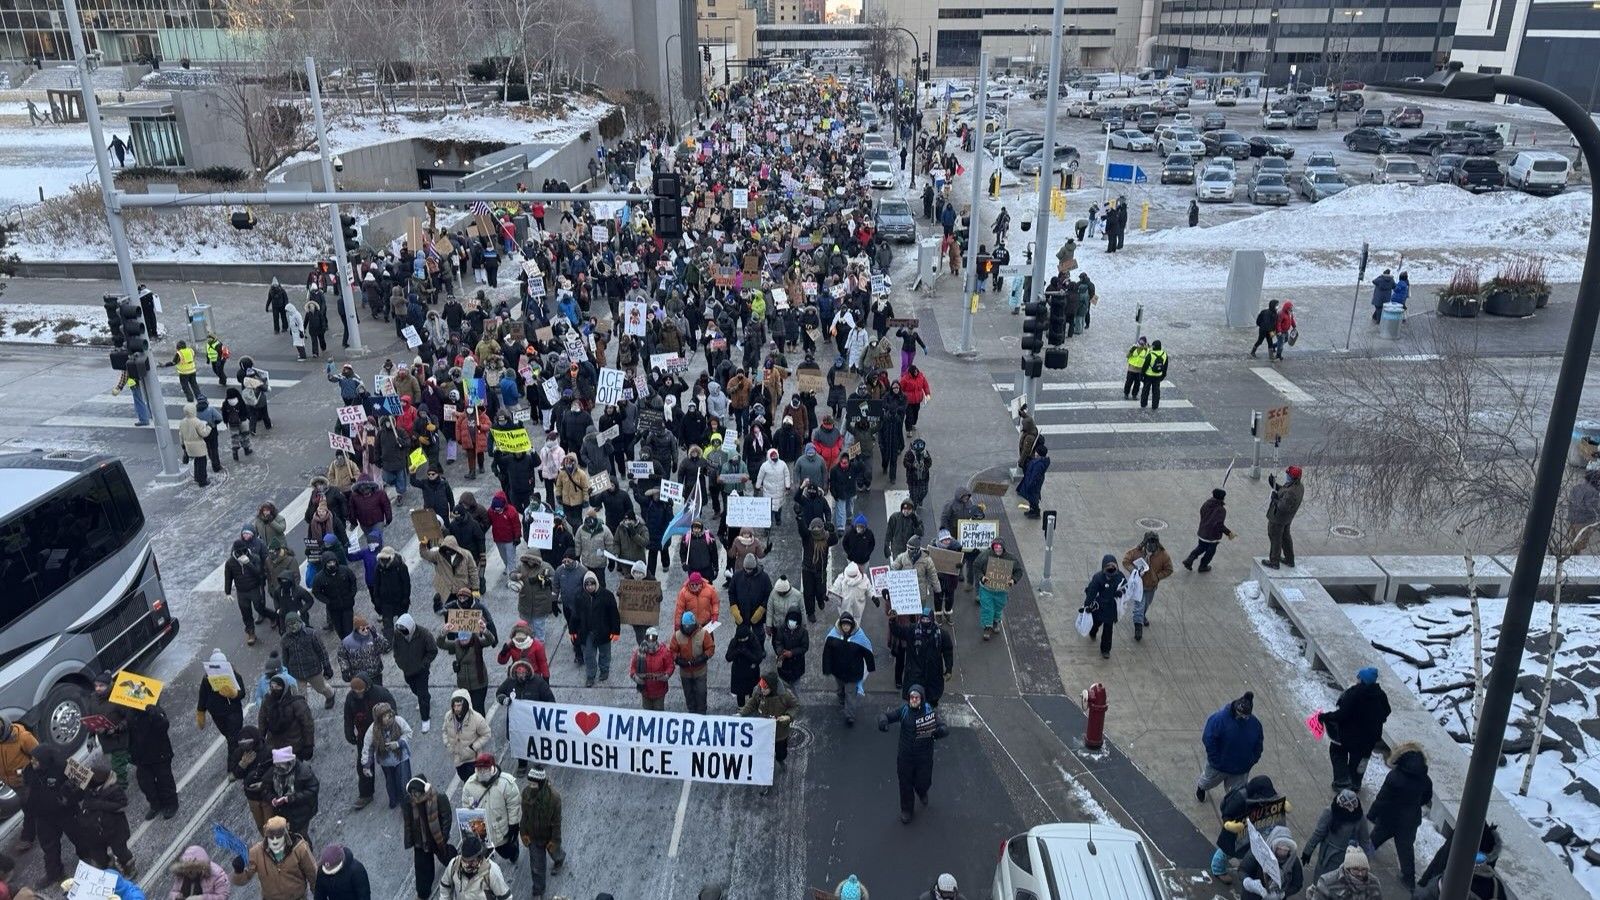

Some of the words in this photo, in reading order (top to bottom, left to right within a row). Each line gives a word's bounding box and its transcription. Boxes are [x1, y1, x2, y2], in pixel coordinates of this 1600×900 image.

[602, 371, 623, 388] ICE
[598, 387, 620, 404] OUT
[339, 407, 360, 415] ICE
[342, 413, 362, 423] OUT
[331, 434, 349, 444] ICE
[332, 441, 351, 451] OUT
[589, 474, 607, 486] ICE
[963, 531, 995, 540] Deporting
[925, 713, 936, 722] OUT
[532, 706, 568, 734] WE
[606, 713, 754, 748] IMMIGRANTS
[527, 735, 618, 769] ABOLISH
[630, 747, 678, 776] I.C.E.
[691, 751, 753, 780] NOW!
